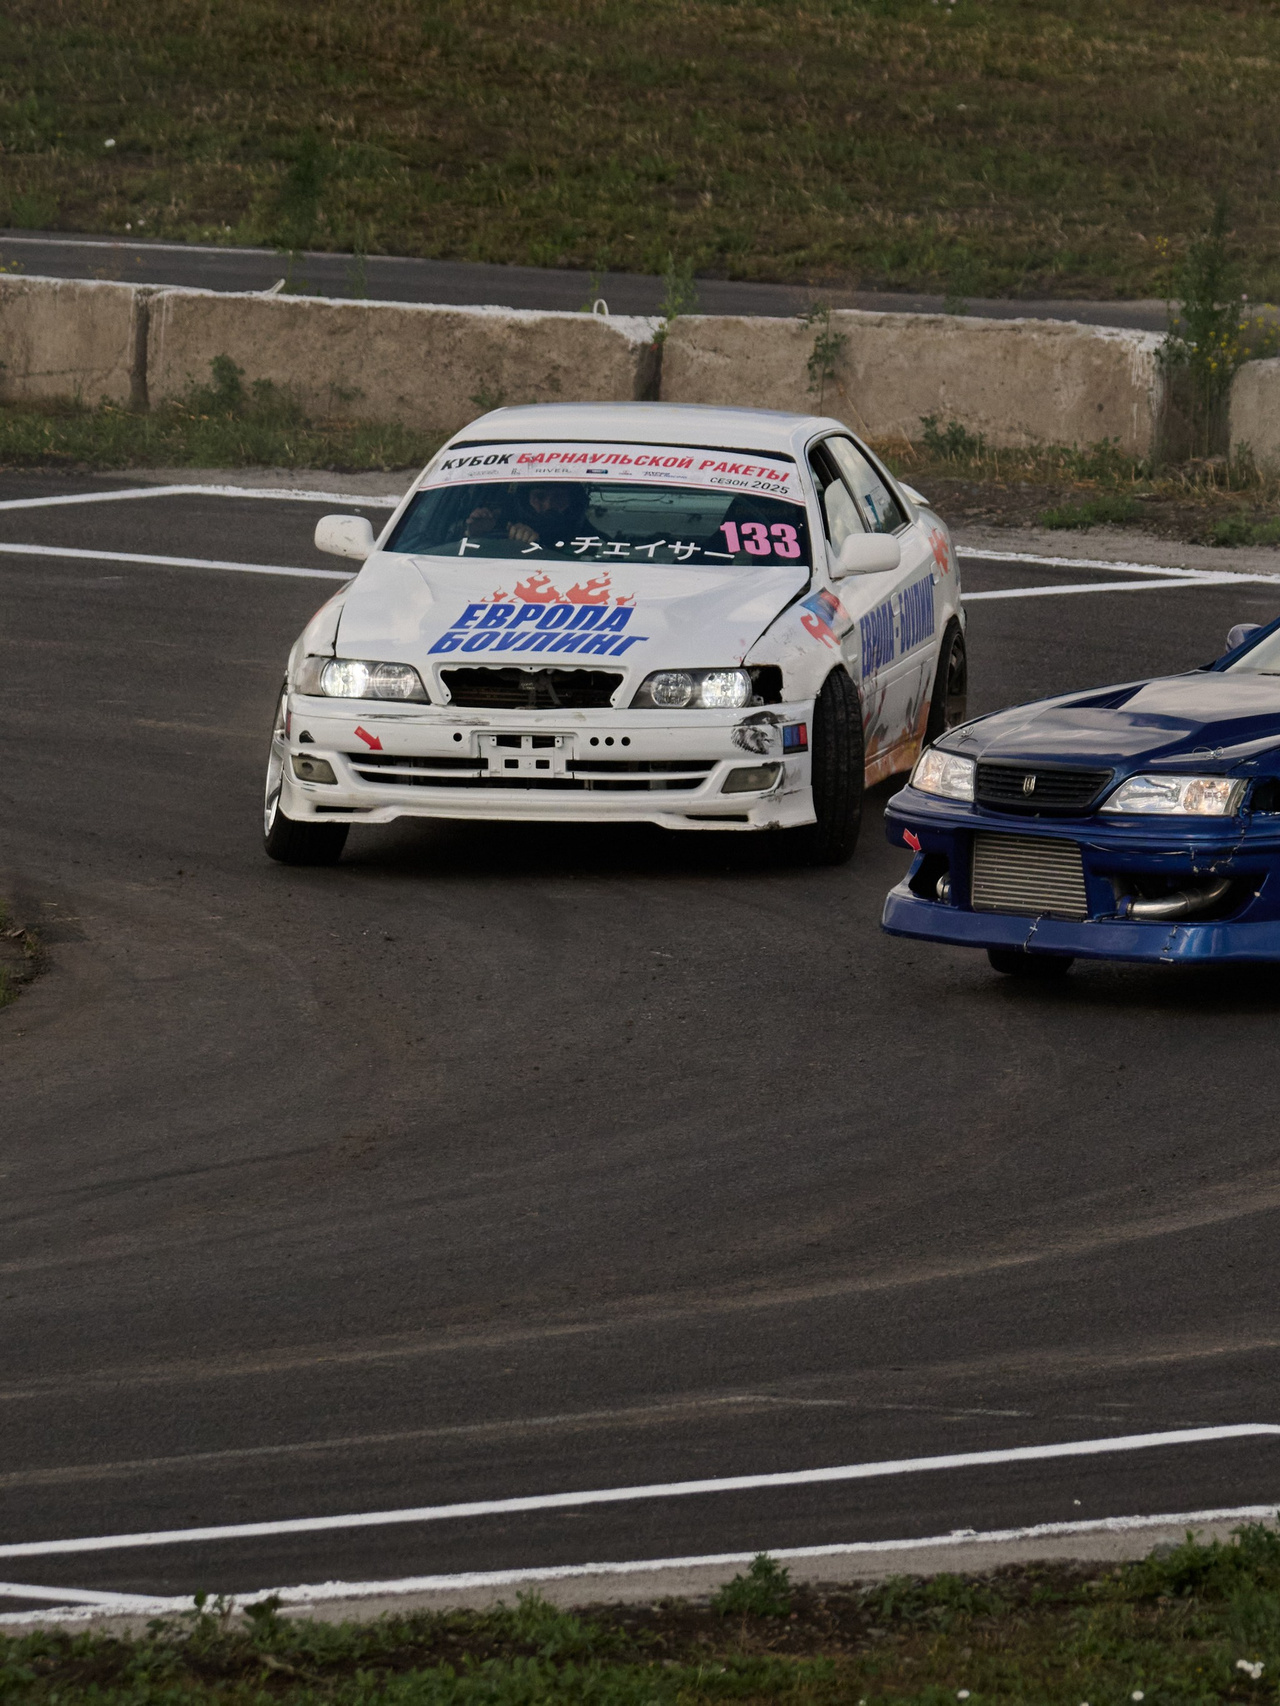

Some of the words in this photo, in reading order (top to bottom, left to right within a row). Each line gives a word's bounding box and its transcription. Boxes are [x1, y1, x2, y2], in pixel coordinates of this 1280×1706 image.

[440, 453, 515, 471] КУБОК
[516, 452, 694, 470] БАРНАУЛЬСКОЙ
[698, 459, 791, 483] РАКЕТЫ
[709, 476, 749, 487] СЕЗОН
[751, 480, 791, 495] 2025
[719, 521, 801, 559] 133
[449, 604, 634, 632] ЕВРОПА
[427, 631, 650, 657] БОУЛИНГ
